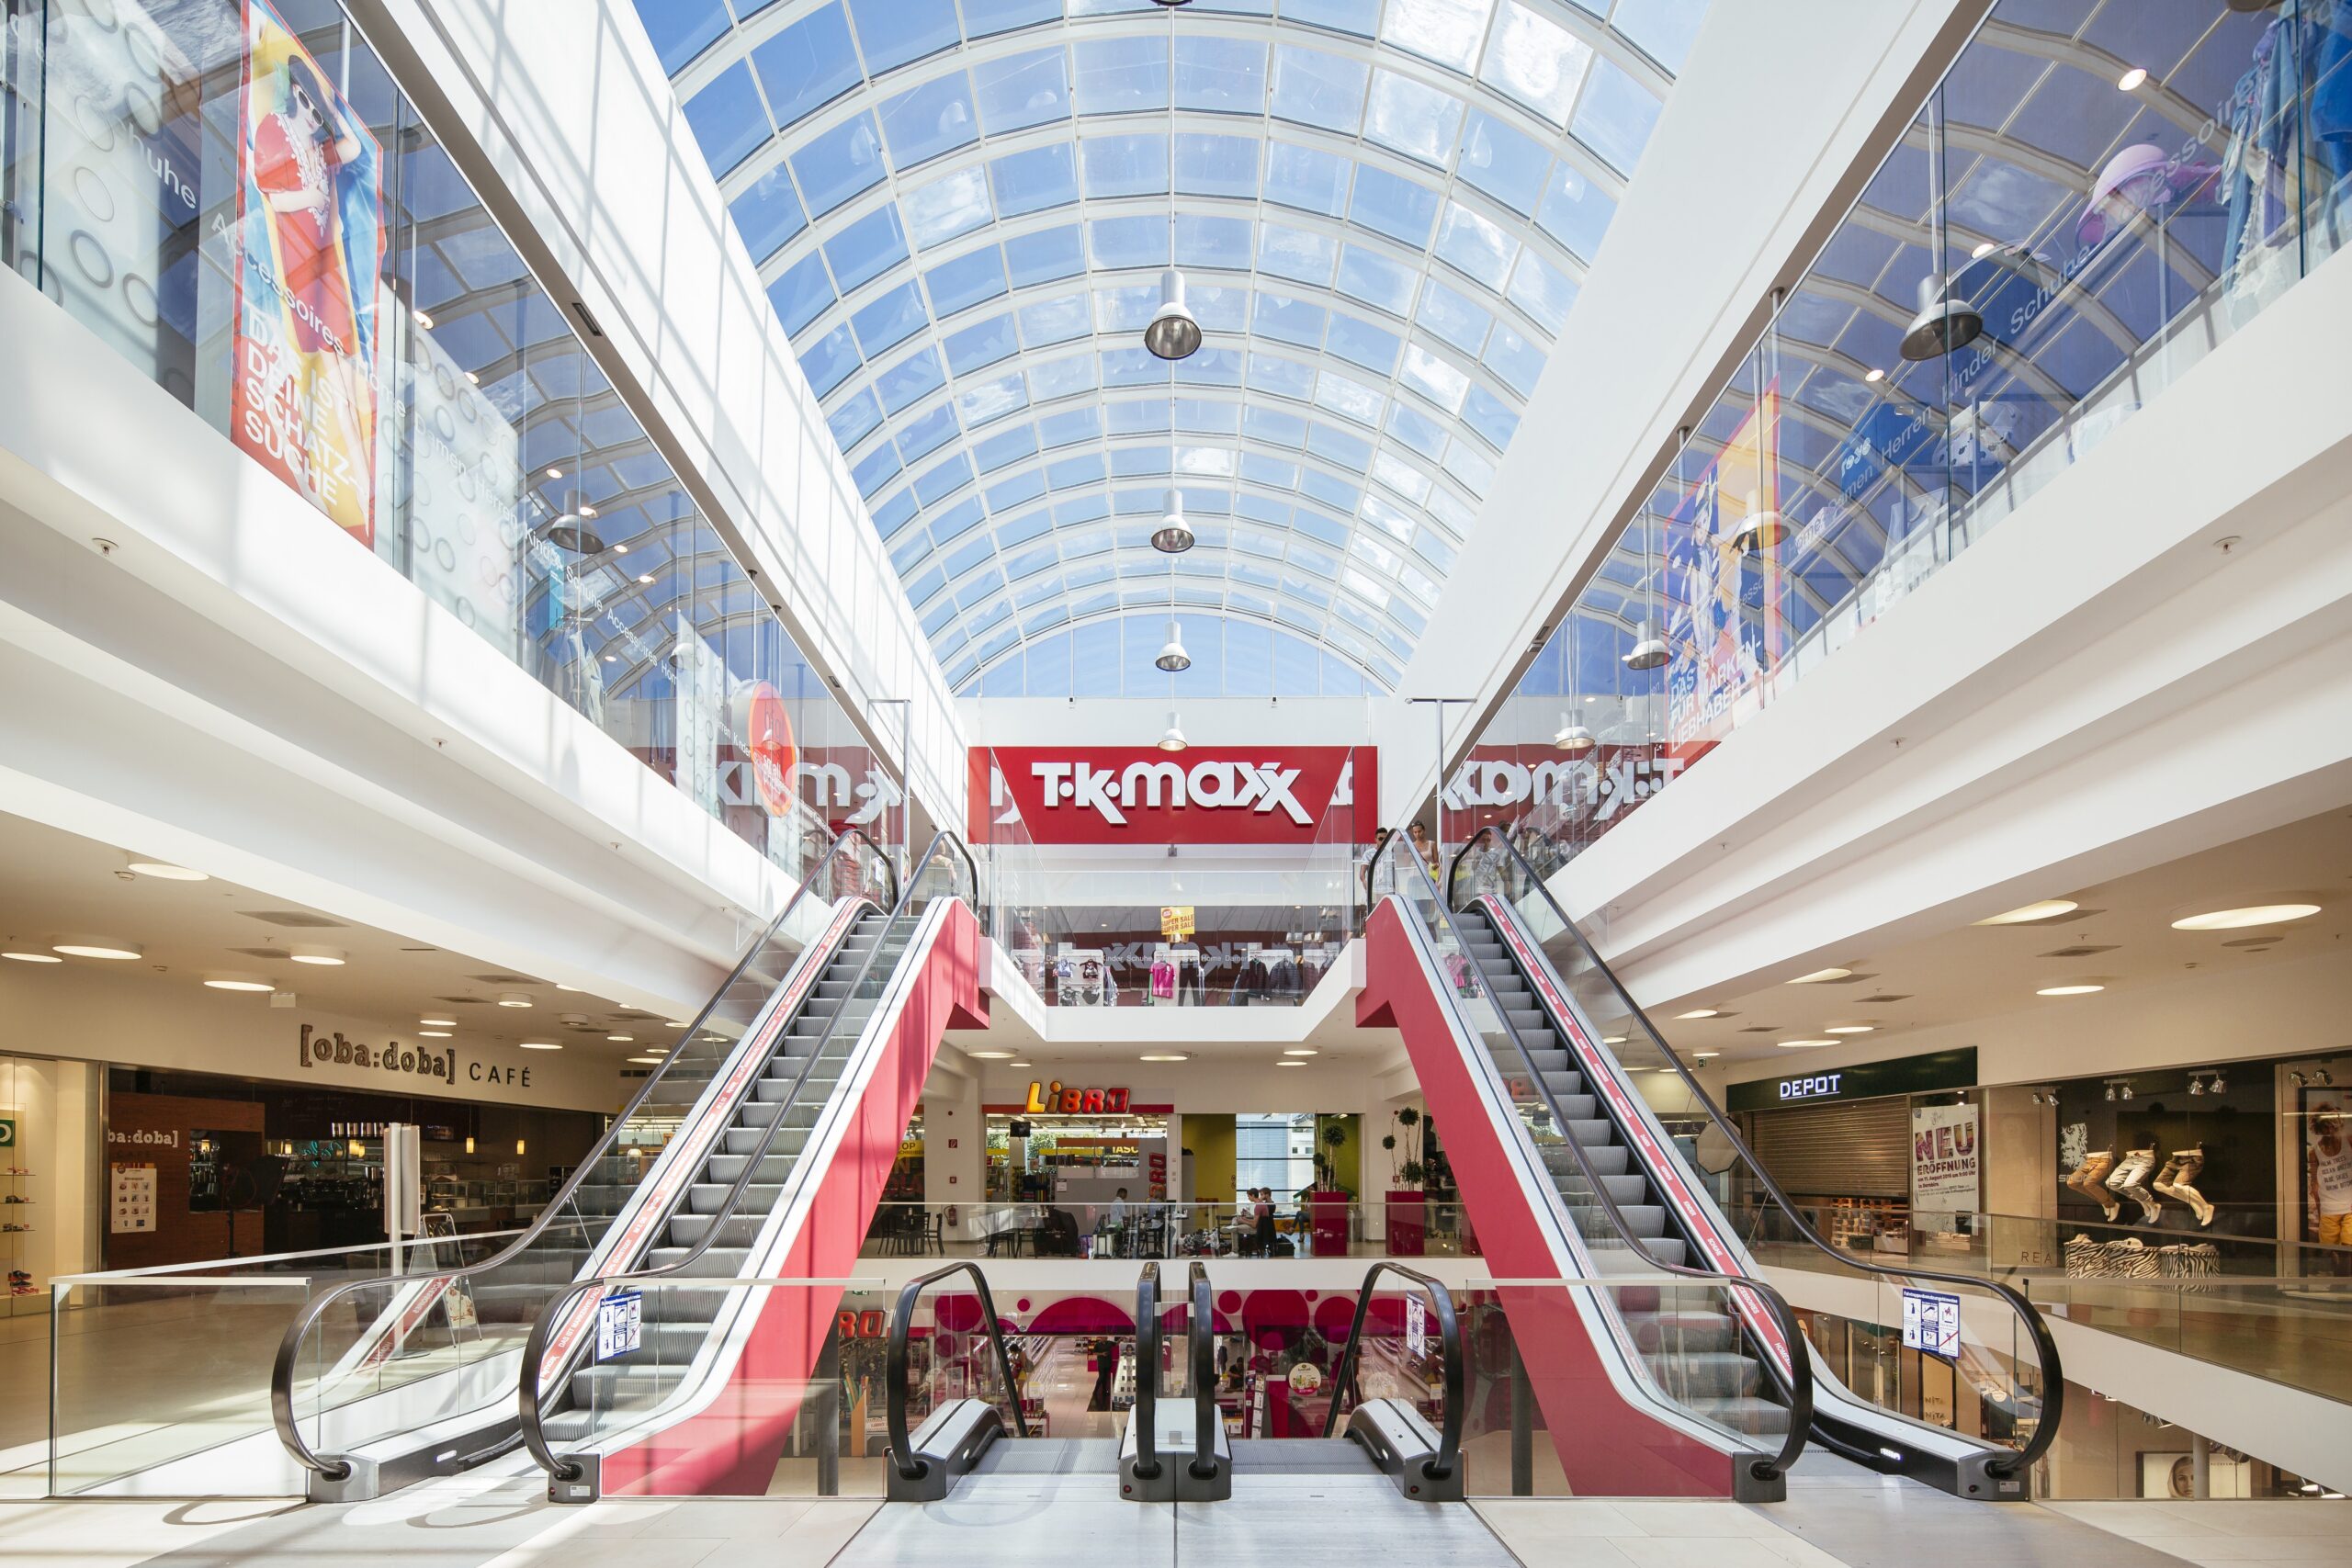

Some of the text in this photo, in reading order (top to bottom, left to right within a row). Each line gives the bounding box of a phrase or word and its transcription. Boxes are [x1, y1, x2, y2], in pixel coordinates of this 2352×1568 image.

[1882, 406, 1931, 466] Herren
[1941, 333, 2000, 406] Kinder
[2009, 243, 2093, 335] Schuhe
[244, 409, 338, 505] SUCHE
[469, 1062, 531, 1088] CAFÉ
[1780, 1074, 1840, 1099] DEPOT
[1915, 1121, 1975, 1163] NEU
[1917, 1157, 1976, 1176] ERÖFFNUNG
